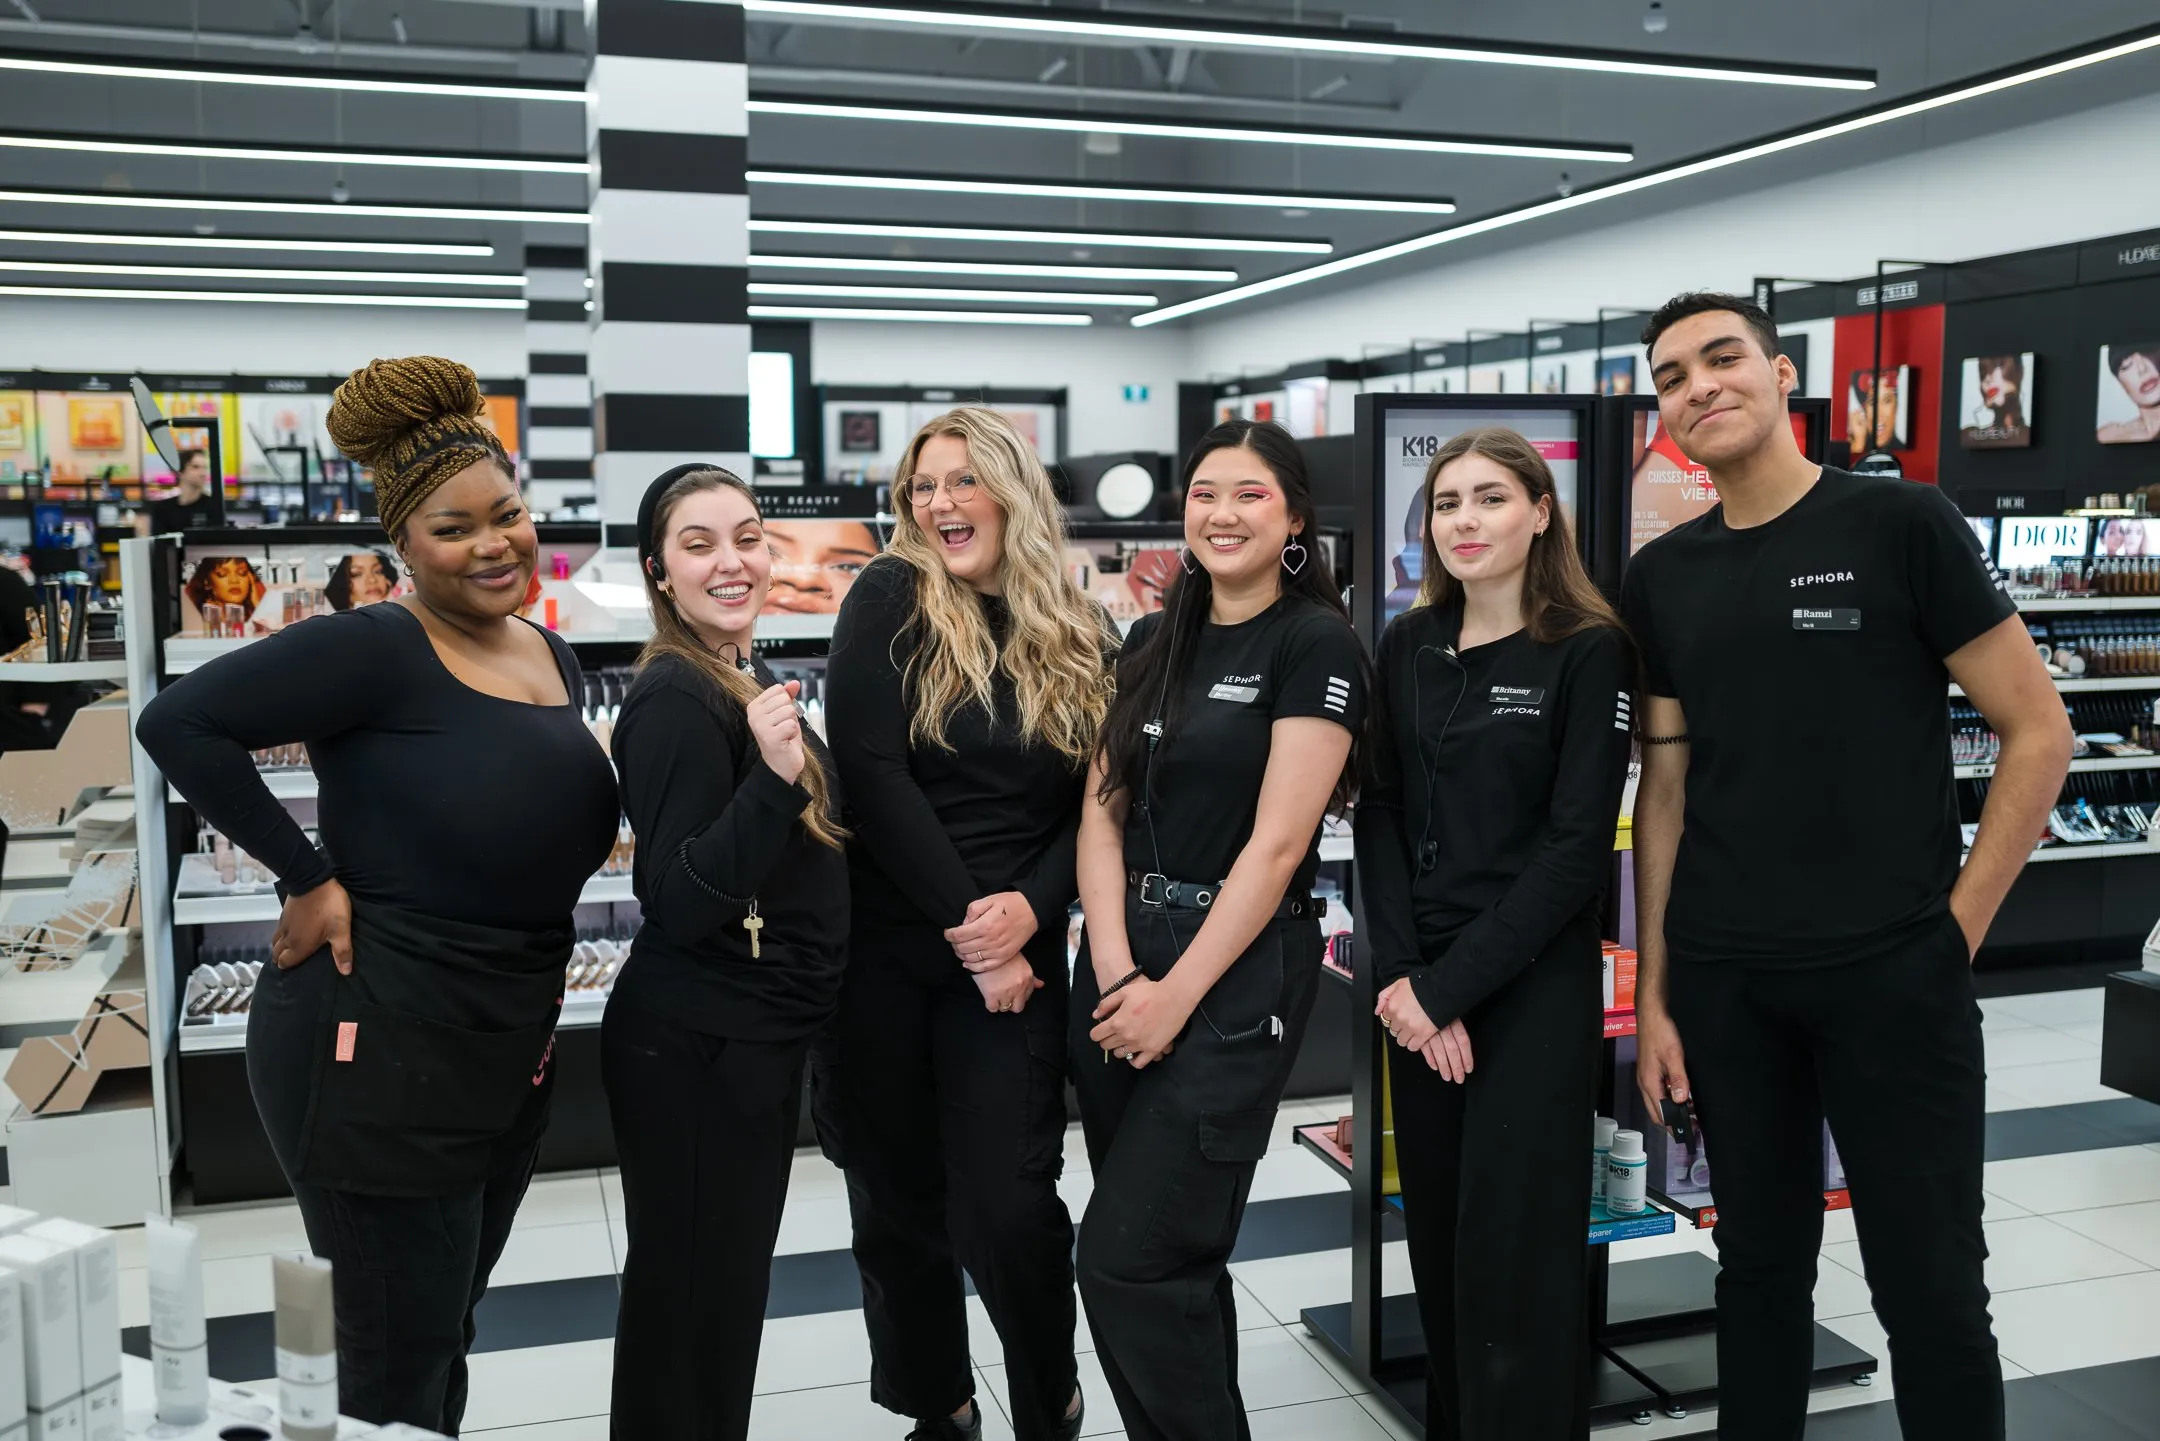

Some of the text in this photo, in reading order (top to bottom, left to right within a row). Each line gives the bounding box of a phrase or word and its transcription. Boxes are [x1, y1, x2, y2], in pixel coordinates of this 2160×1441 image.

[1403, 436, 1438, 456] K18
[1648, 470, 1681, 484] CUISSES
[788, 496, 839, 505] BEAUTY
[1681, 487, 1705, 501] VIE
[1996, 496, 2024, 510] DIOR
[2013, 525, 2077, 546] DIOR
[1790, 571, 1854, 588] SEPHORA
[1803, 609, 1832, 618] Ramzi
[1222, 674, 1263, 684] SEPHOR
[1499, 686, 1531, 696] Britanny
[1613, 1167, 1630, 1177] K18
